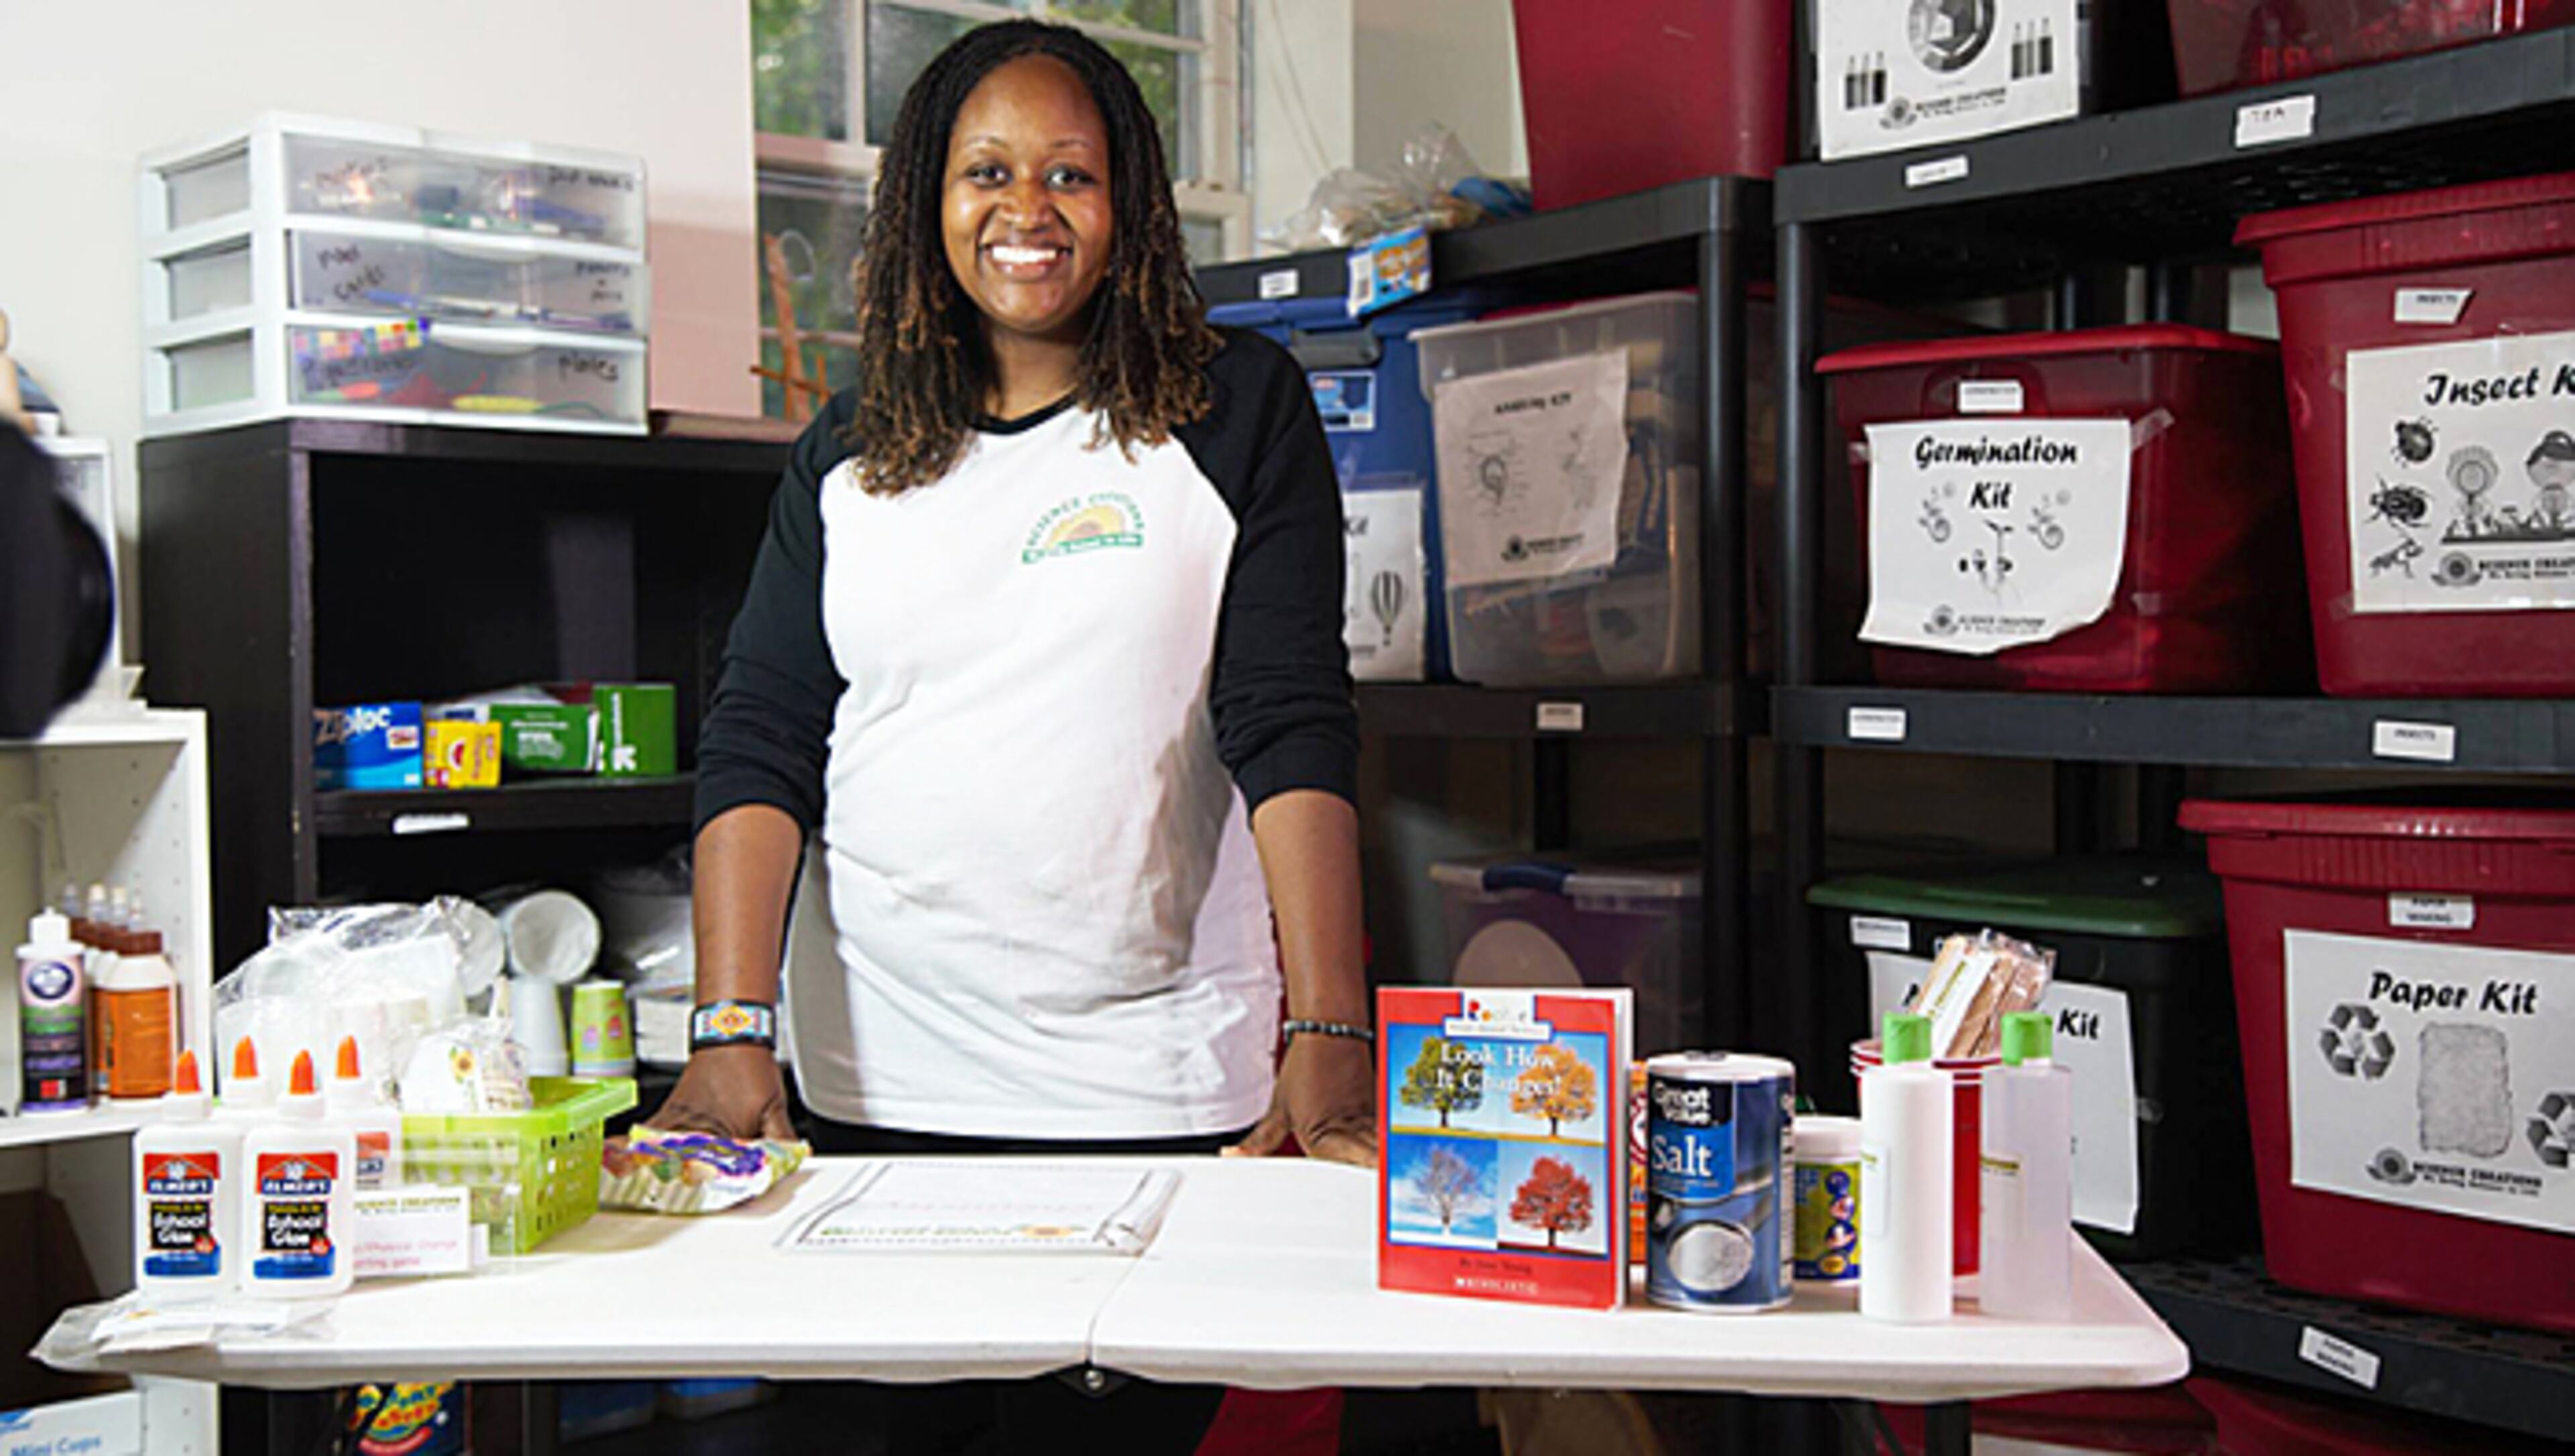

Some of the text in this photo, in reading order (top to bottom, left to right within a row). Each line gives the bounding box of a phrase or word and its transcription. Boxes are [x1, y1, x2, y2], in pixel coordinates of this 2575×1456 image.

[2423, 366, 2541, 405] Insect
[1915, 436, 2078, 469] Germination
[1969, 482, 2012, 509] Kit
[312, 706, 391, 745] Ziploc
[2369, 970, 2538, 1015] Paper Kit
[2057, 1008, 2100, 1040] Kit
[1441, 1042, 1556, 1069] Look How
[1652, 1134, 1713, 1178] Salt
[56, 1435, 102, 1454] Cups
